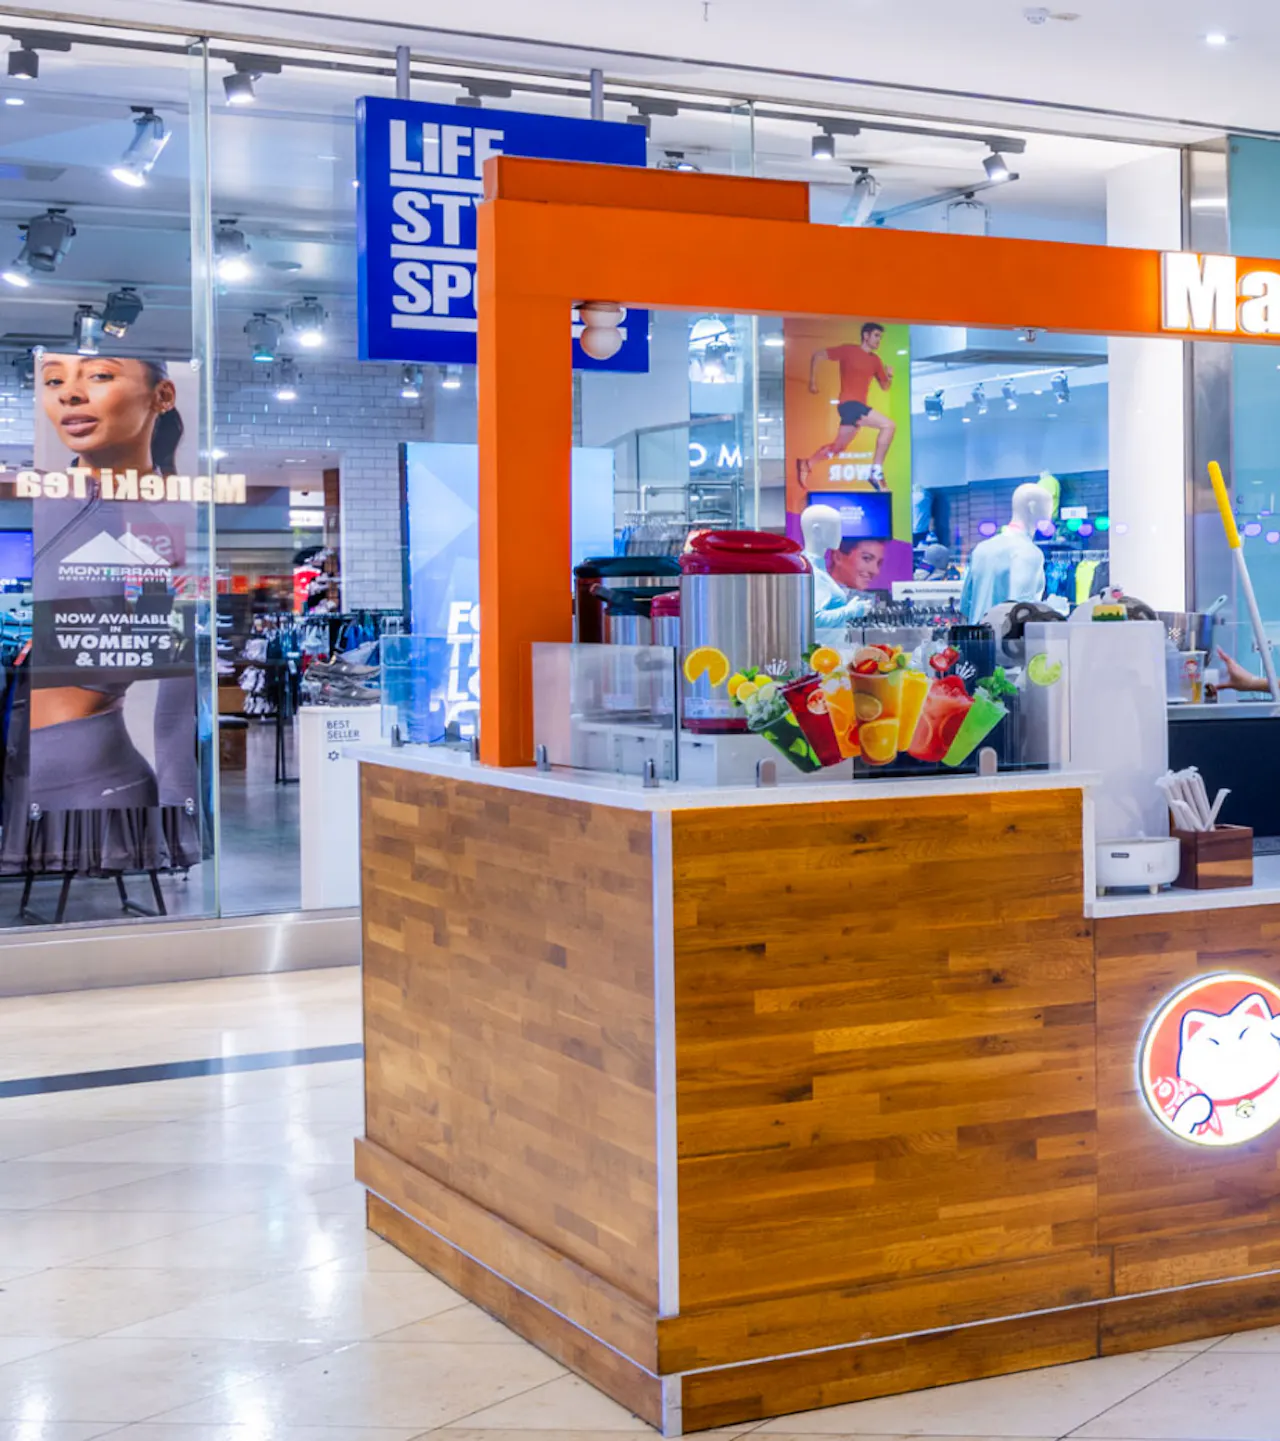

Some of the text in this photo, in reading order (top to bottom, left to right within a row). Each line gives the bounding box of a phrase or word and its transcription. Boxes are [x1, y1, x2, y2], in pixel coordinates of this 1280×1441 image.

[58, 566, 172, 577] MONTERRAIN
[55, 613, 96, 624] NOW
[75, 652, 154, 667] & KIDS
[326, 720, 351, 730] BEST
[327, 730, 360, 740] SELLER
